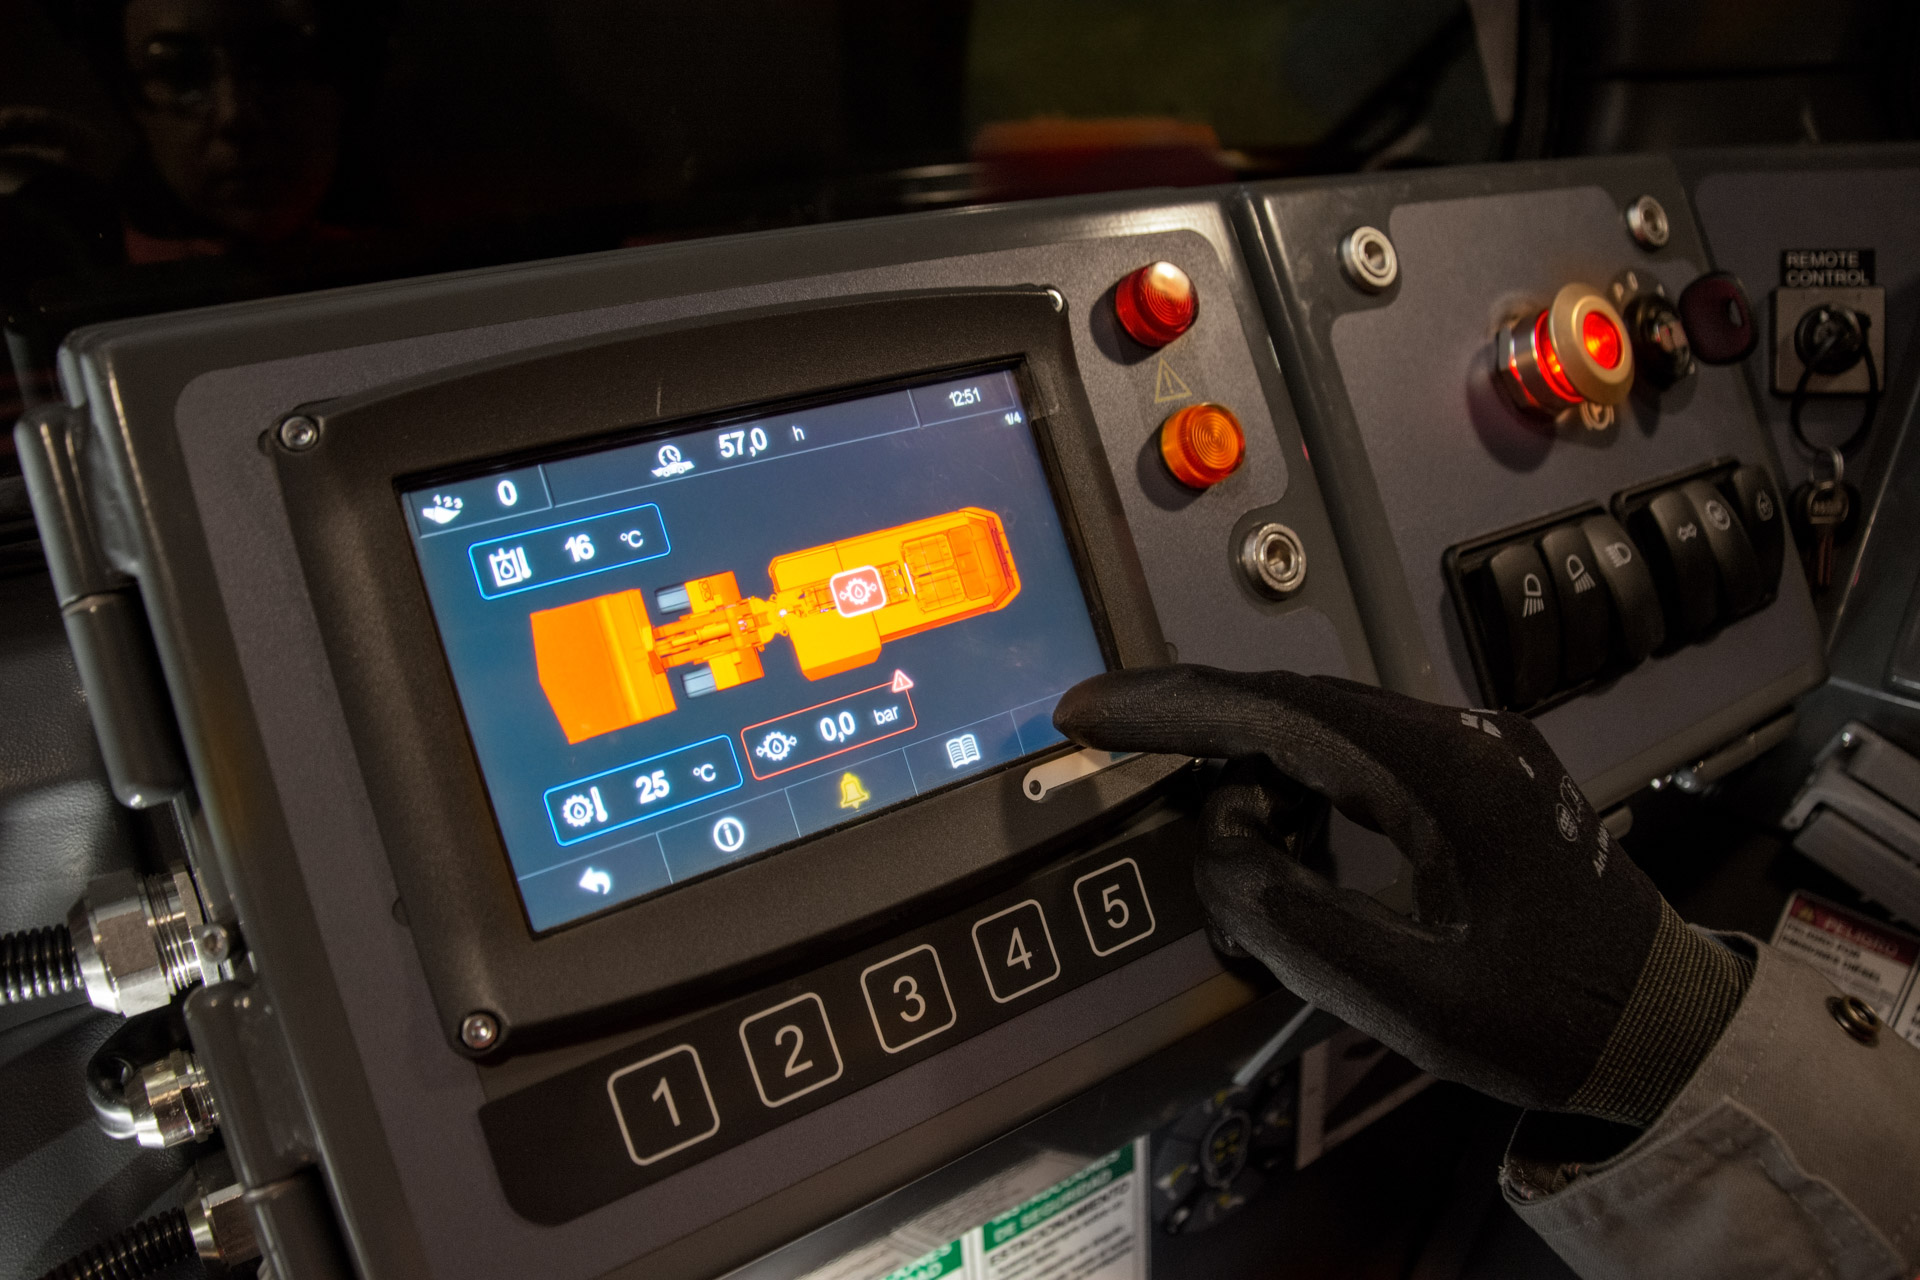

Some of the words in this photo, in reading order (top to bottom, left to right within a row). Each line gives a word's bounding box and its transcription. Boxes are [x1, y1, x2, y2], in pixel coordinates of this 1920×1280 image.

[1786, 250, 1859, 268] REMOTE
[1786, 269, 1869, 287] CONTROL
[949, 387, 982, 408] 12:51
[1004, 412, 1023, 426] 1/4
[719, 427, 768, 458] 57,0
[792, 426, 806, 442] h
[497, 479, 518, 507] 0
[565, 533, 596, 563] 16
[818, 710, 856, 743] 0,0
[873, 704, 900, 726] bar
[634, 769, 671, 804] 25
[1102, 884, 1130, 930] 5
[1006, 926, 1033, 972] 4
[892, 975, 927, 1023] 3
[774, 1024, 814, 1078] 2
[651, 1076, 682, 1127] 1
